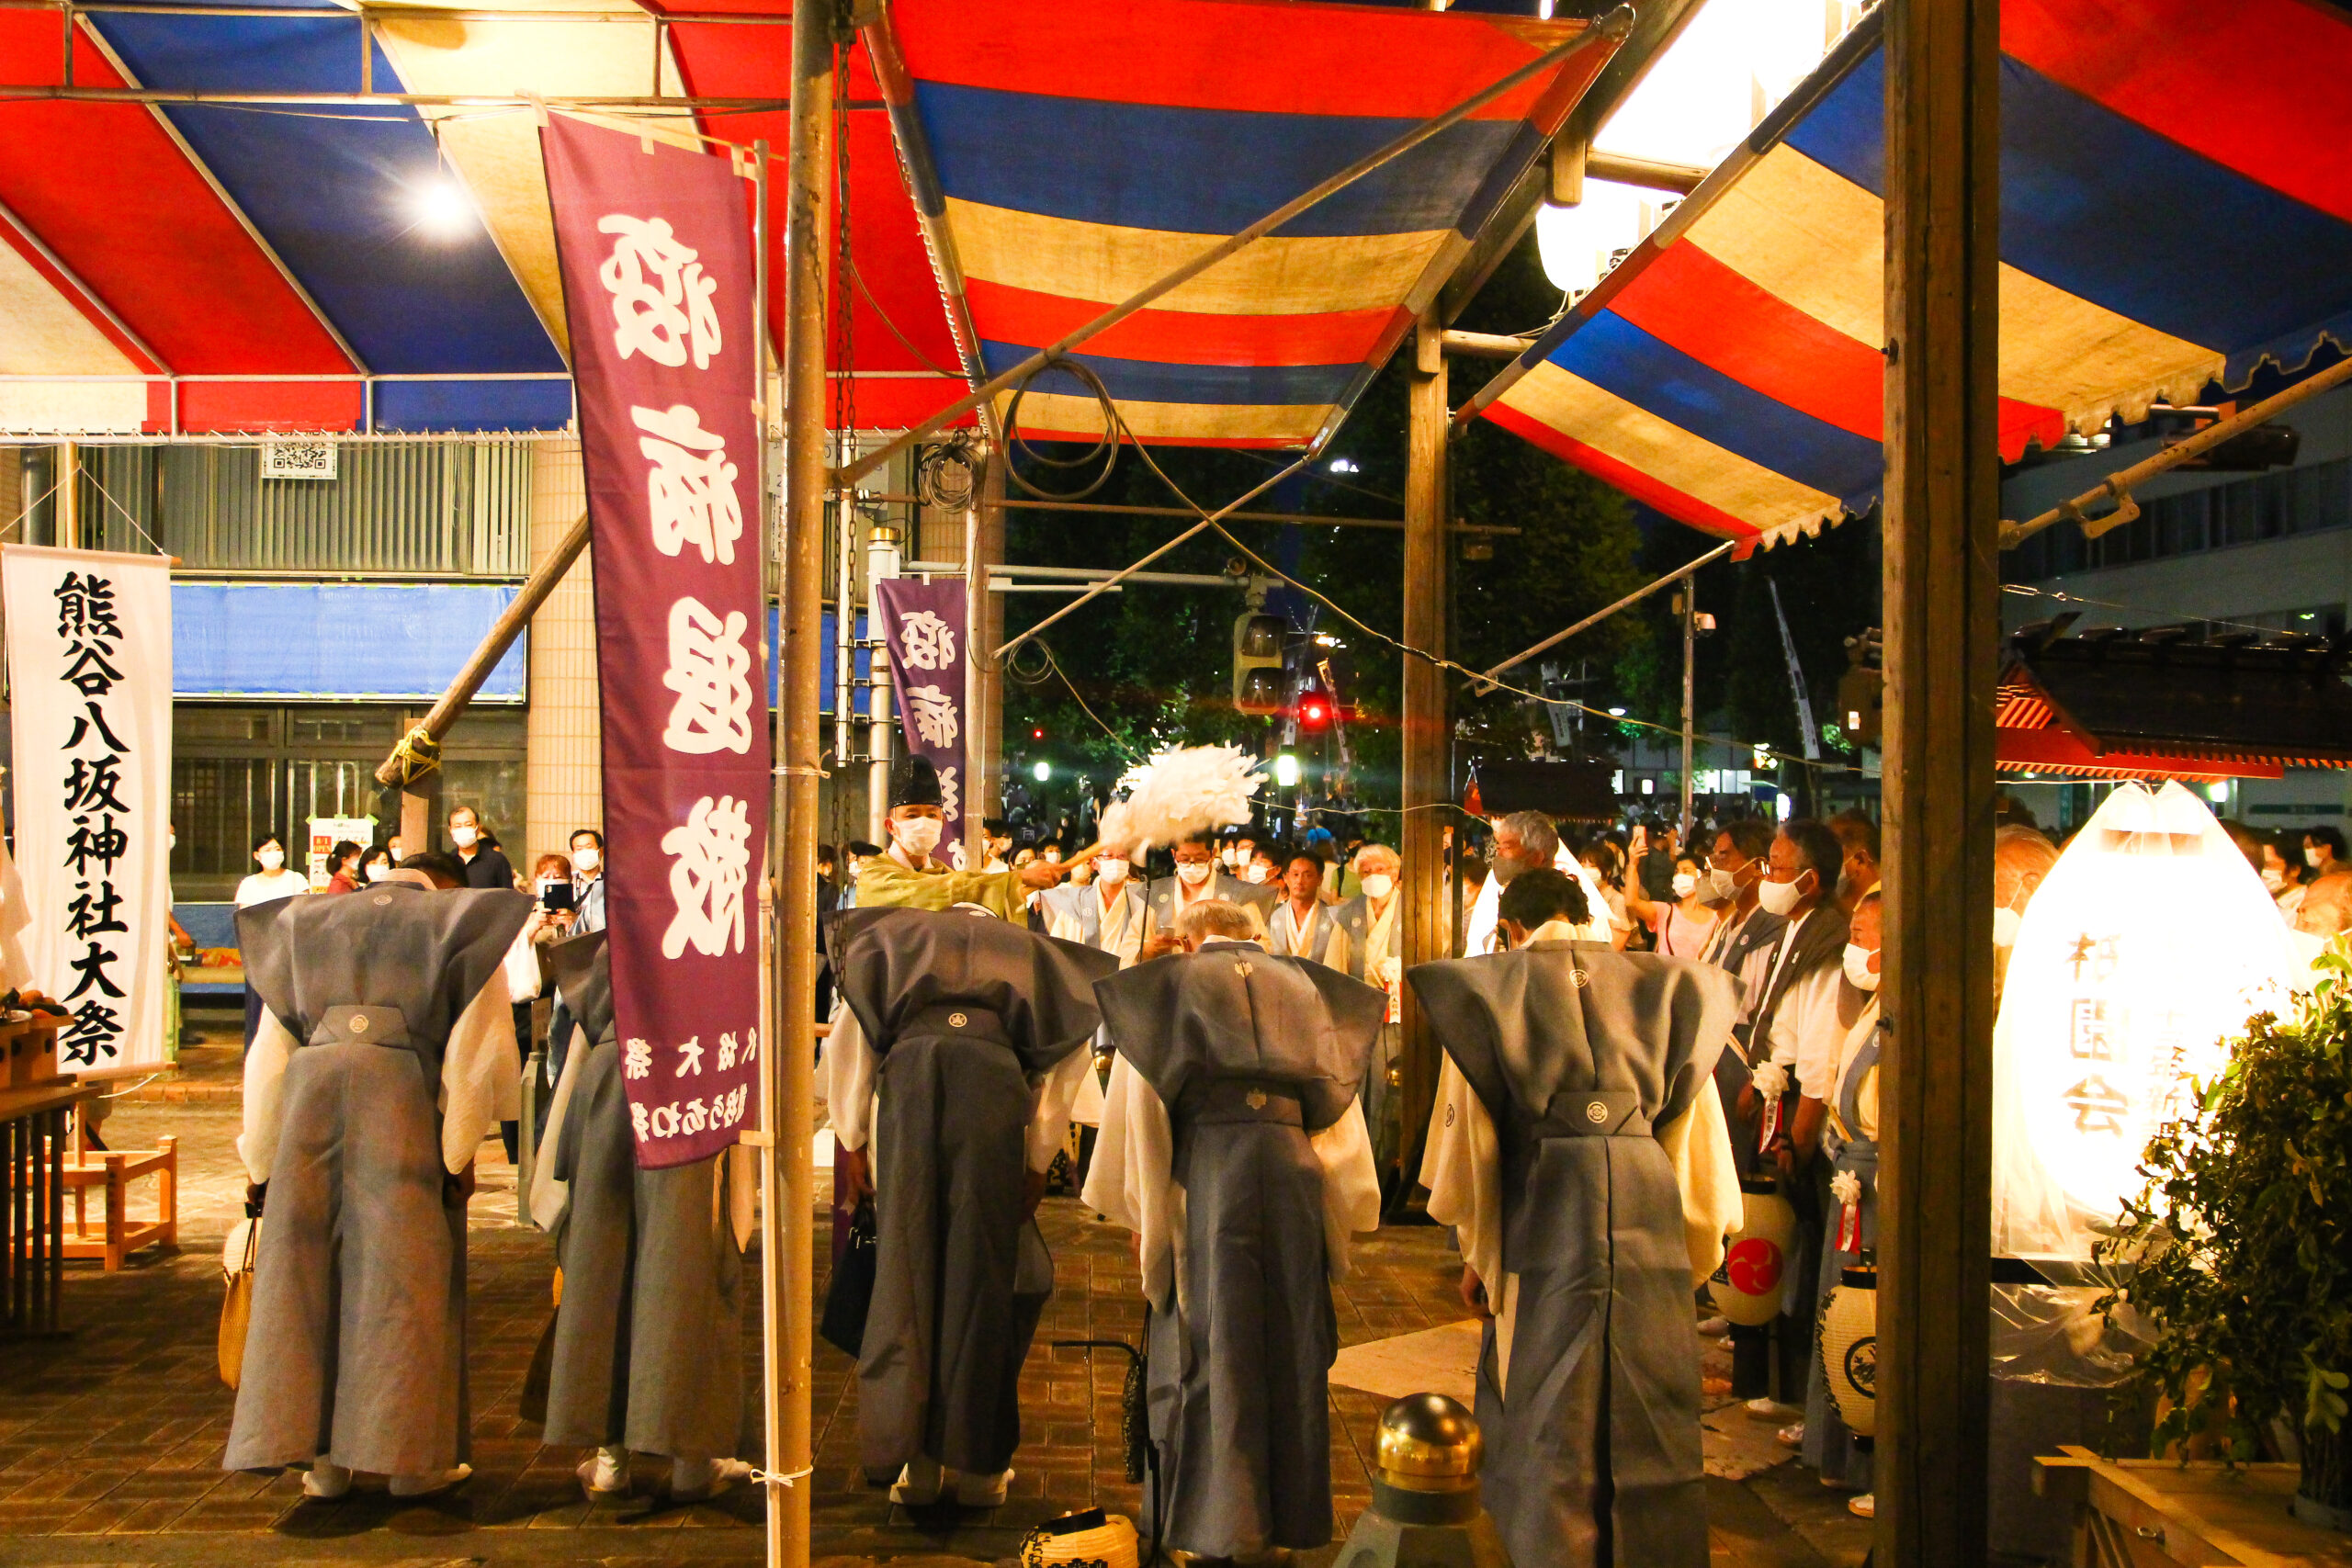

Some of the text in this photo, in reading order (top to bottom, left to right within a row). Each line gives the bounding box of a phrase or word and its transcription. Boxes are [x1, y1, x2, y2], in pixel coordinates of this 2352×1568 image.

[53, 570, 131, 1067] 熊谷八坂神社大祭
[313, 845, 332, 853] OPEN
